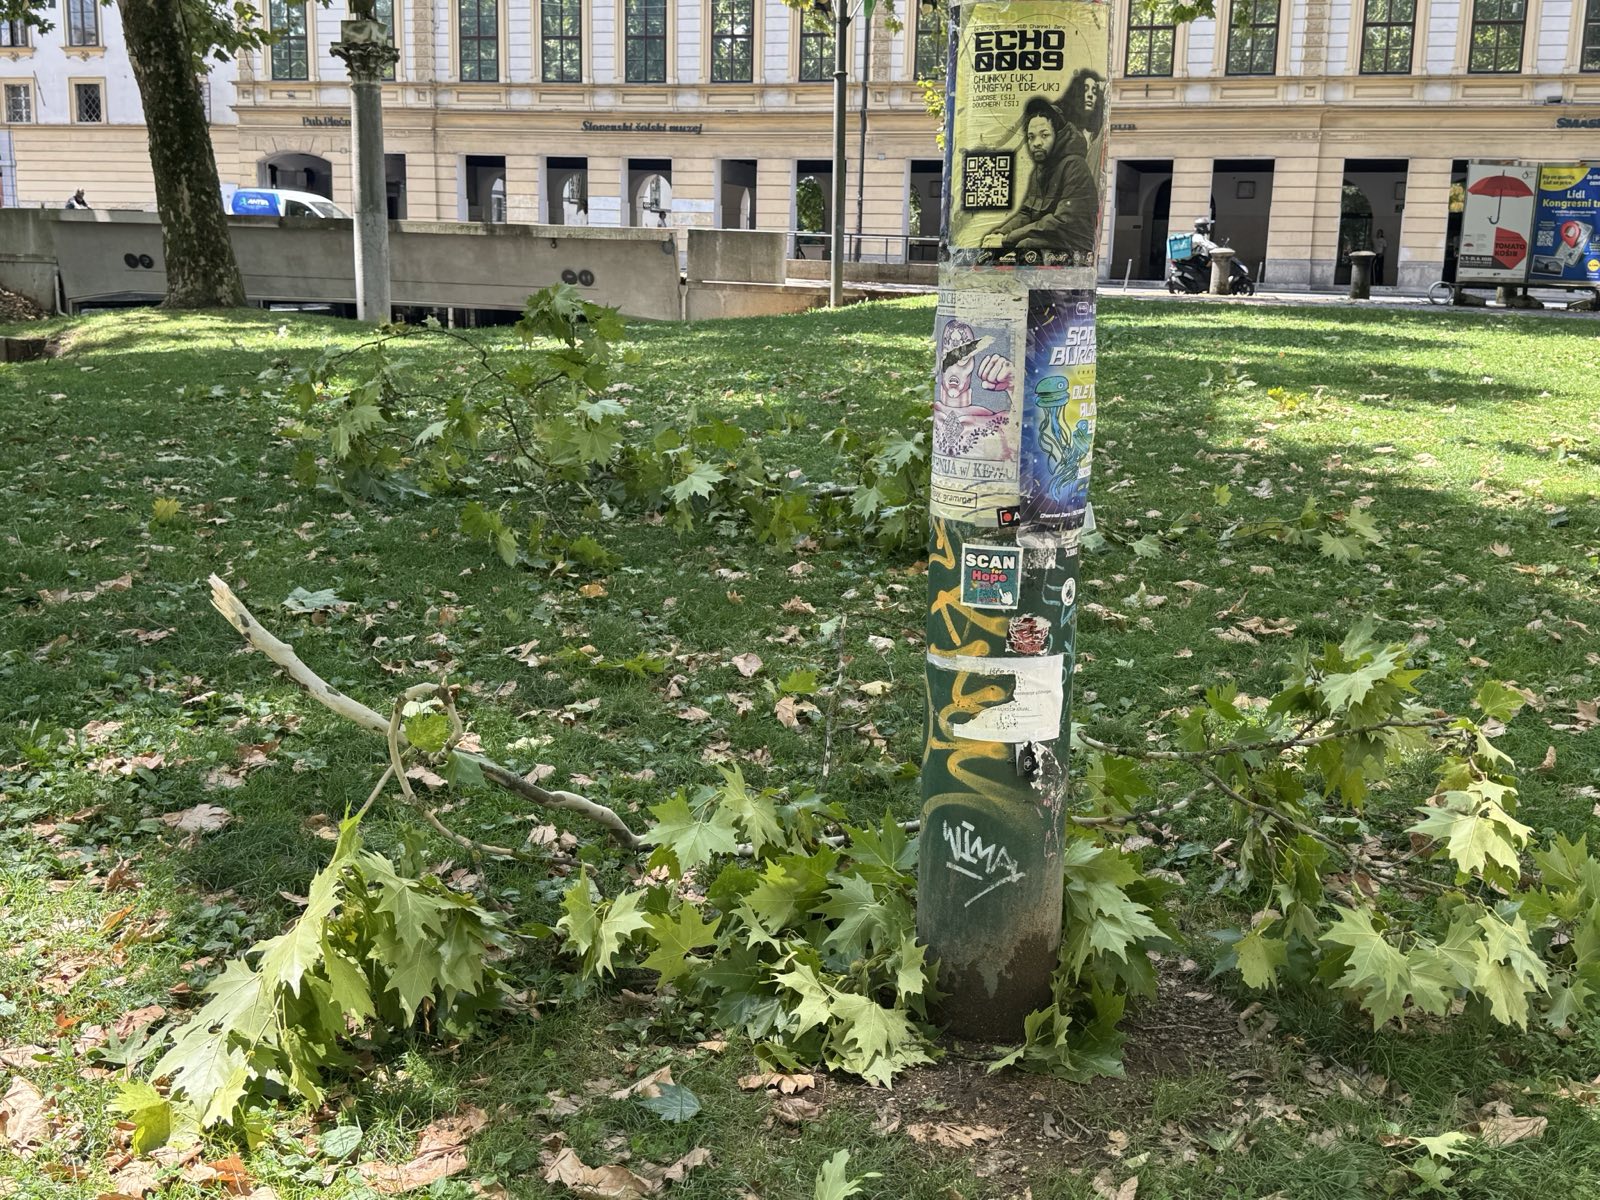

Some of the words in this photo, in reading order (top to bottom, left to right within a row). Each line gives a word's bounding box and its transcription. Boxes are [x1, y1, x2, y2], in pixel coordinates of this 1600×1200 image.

[975, 30, 1065, 52] ECHO
[975, 51, 1064, 72] 0009
[974, 75, 1006, 84] CHUNKY
[581, 120, 633, 132] Slovenski
[669, 123, 703, 134] muzej
[1567, 190, 1585, 199] Lidl
[1543, 199, 1592, 209] Kongresni
[966, 553, 1016, 569] SCAN
[972, 570, 1008, 583] Hope
